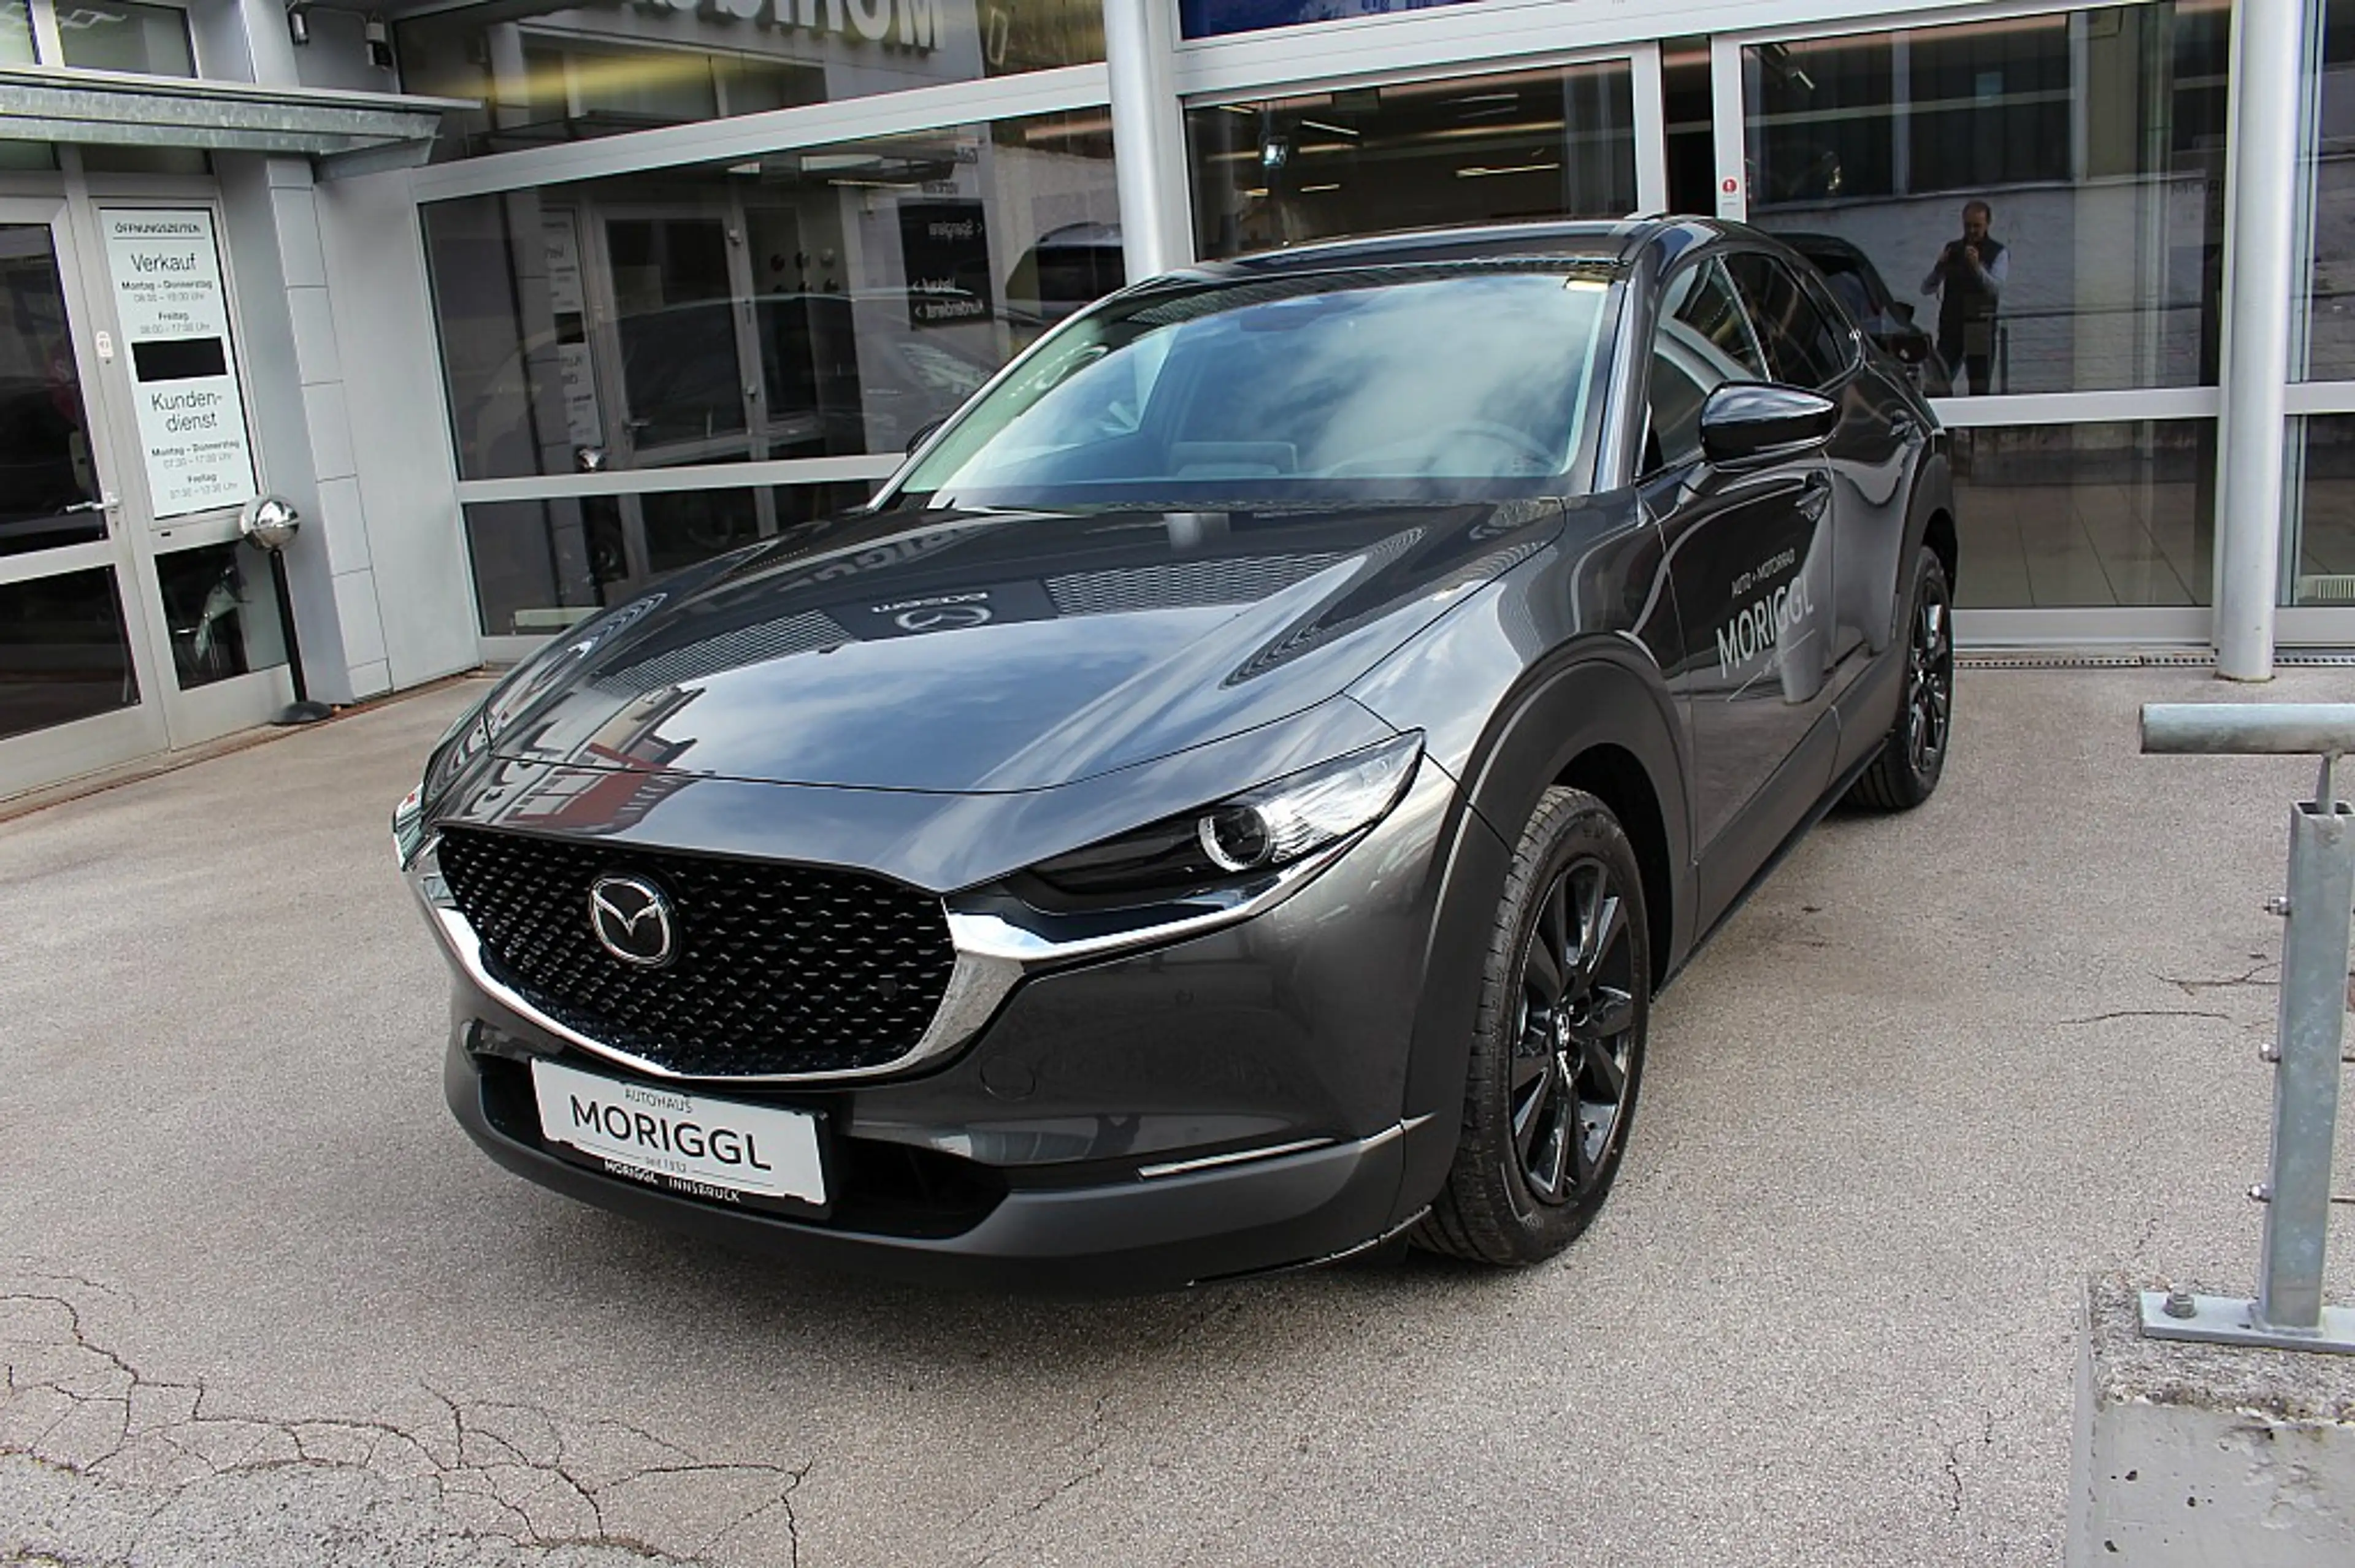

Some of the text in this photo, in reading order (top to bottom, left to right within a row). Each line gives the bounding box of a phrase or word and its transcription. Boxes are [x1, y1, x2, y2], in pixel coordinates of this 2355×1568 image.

[131, 253, 197, 272] Verkauf
[121, 281, 155, 291] Montag
[163, 280, 212, 291] Donnerstag
[158, 312, 190, 321] Freitag
[151, 391, 223, 411] Kunden-
[166, 412, 218, 433] dienst
[151, 447, 185, 457] Montag
[1716, 575, 1814, 679] MORIGGL
[624, 1088, 694, 1114] AUTOHAUS
[570, 1094, 772, 1171] MORIGGL
[603, 1158, 741, 1203] MORIGGL INNSBRUCK
